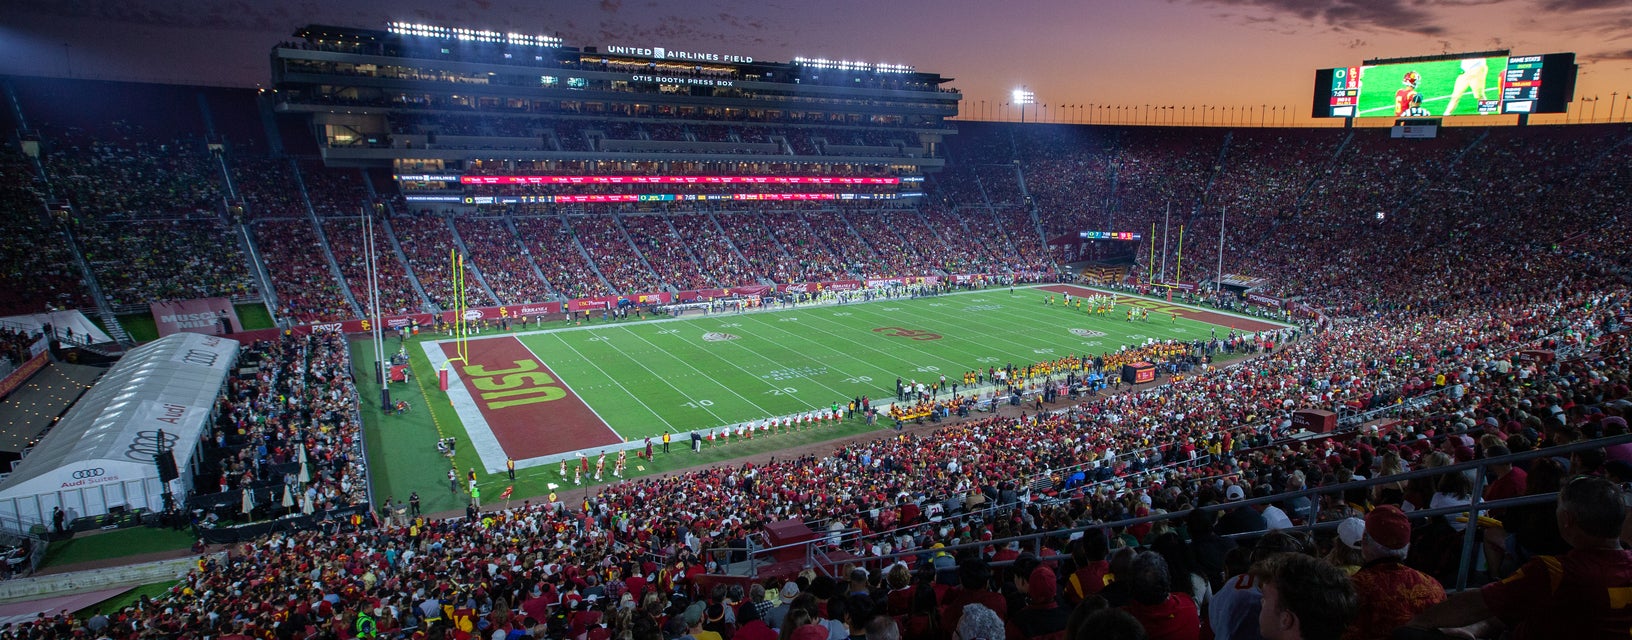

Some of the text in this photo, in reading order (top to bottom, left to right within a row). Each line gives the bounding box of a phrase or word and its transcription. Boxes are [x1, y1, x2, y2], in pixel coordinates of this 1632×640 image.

[608, 45, 753, 63] UNITED AIRLINES FIELD
[161, 311, 219, 323] MUSCL
[462, 358, 567, 410] USC
[767, 386, 798, 396] 20
[156, 403, 187, 425] Audi
[61, 475, 119, 488] Audi Suites
